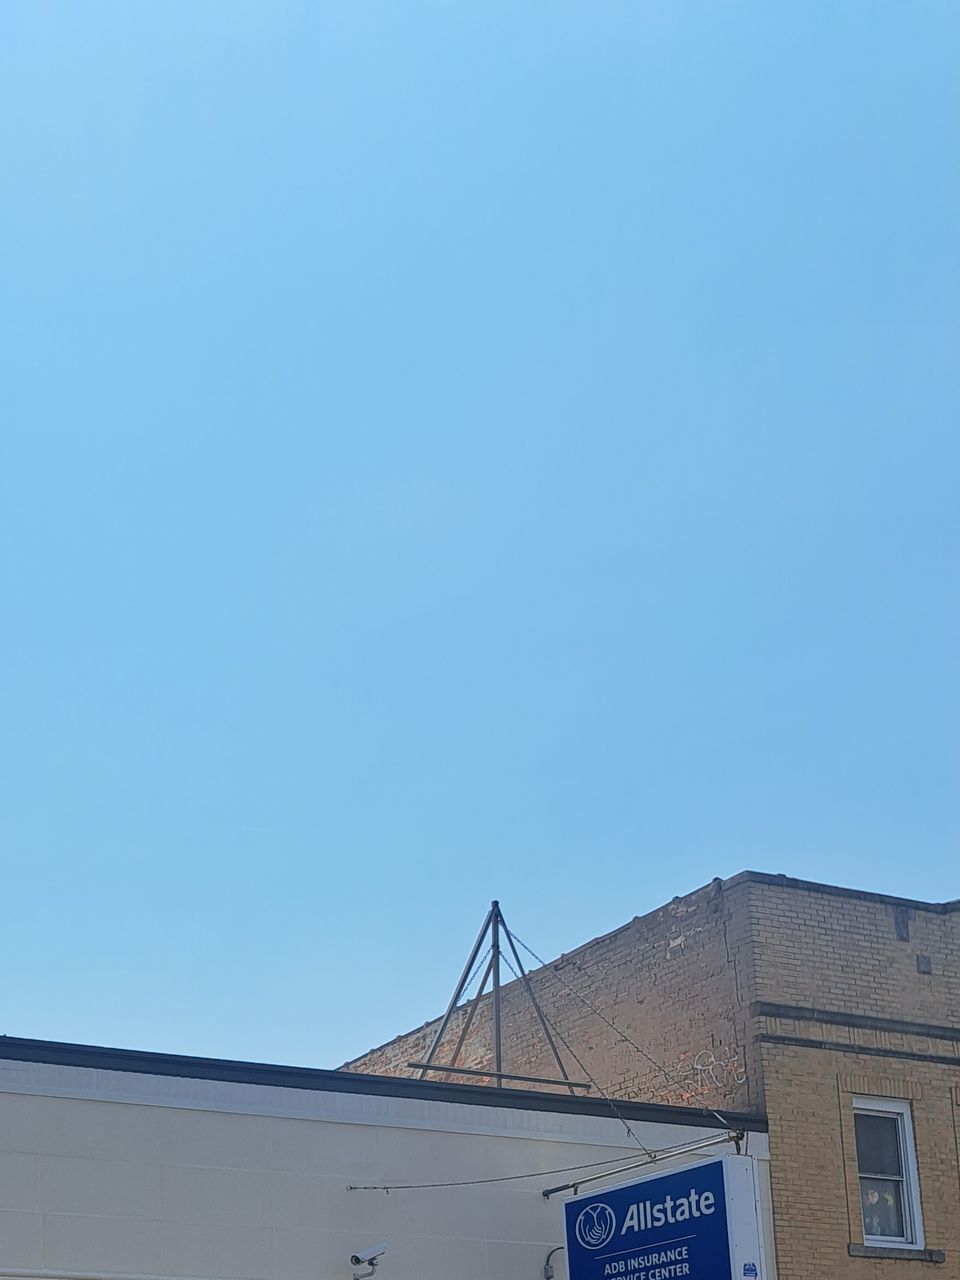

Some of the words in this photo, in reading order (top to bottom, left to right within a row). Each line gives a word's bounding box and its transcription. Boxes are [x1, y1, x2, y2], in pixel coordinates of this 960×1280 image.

[620, 1188, 716, 1235] Allstate
[603, 1259, 626, 1277] ADB
[627, 1246, 689, 1271] INSURANCE
